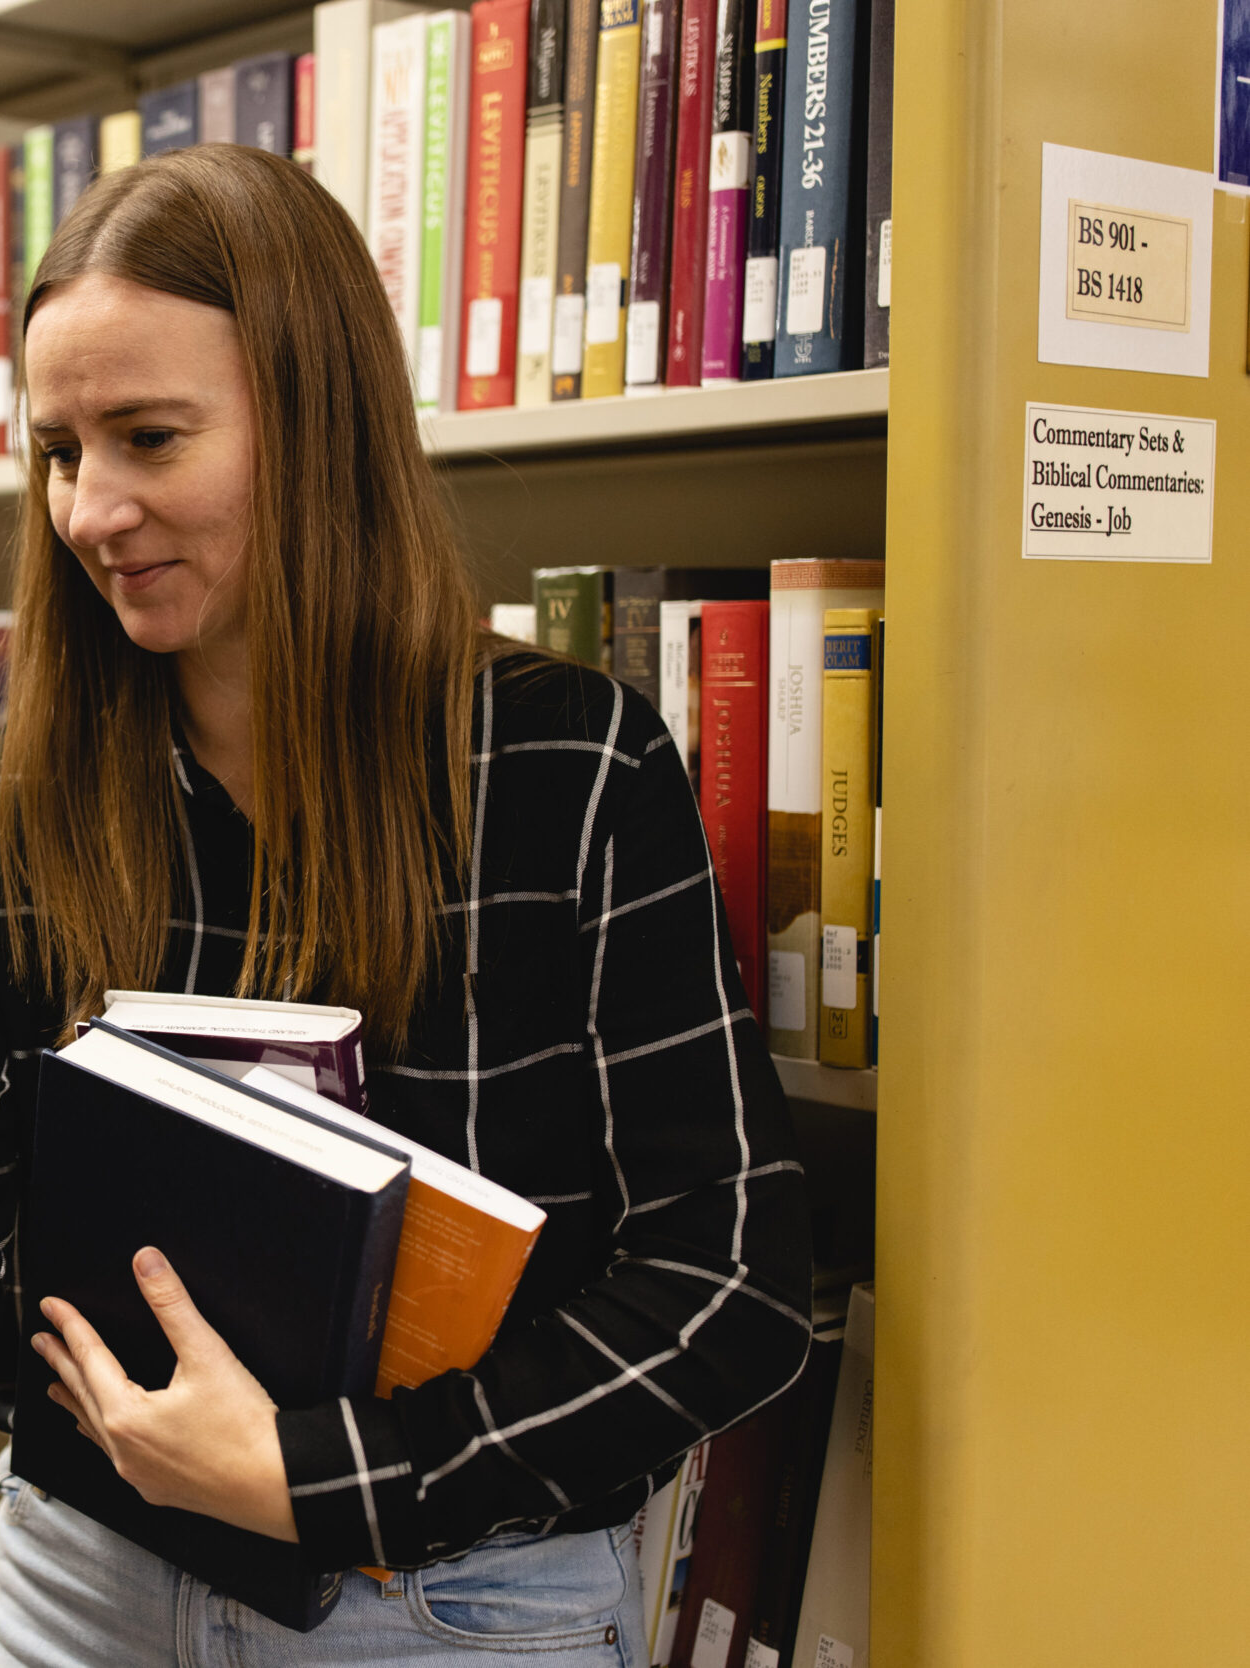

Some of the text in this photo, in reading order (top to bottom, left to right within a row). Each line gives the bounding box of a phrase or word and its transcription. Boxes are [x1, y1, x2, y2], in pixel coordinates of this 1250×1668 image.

[717, 33, 734, 123] NUMBERS
[801, 0, 830, 190] UMBERS 21-36
[756, 73, 773, 155] Numbers
[478, 90, 503, 245] LEVITICUS
[805, 209, 815, 249] BARUC
[1078, 216, 1104, 247] BS
[1108, 222, 1136, 253] 901
[1077, 268, 1144, 304] BS 1418
[1033, 417, 1185, 456] Commentary Sets &
[1032, 460, 1205, 495] Biblical Commentaries:
[1030, 502, 1092, 530] Genesis
[1105, 506, 1132, 537] Job
[549, 599, 573, 620] IV
[825, 640, 861, 654] BERIT
[825, 654, 860, 669] OLAM
[777, 678, 787, 722] SHARP
[788, 664, 804, 736] JOSHUA
[713, 699, 733, 809] JOSHUA
[831, 769, 848, 857] JUDGES
[820, 1637, 835, 1648] Ref
